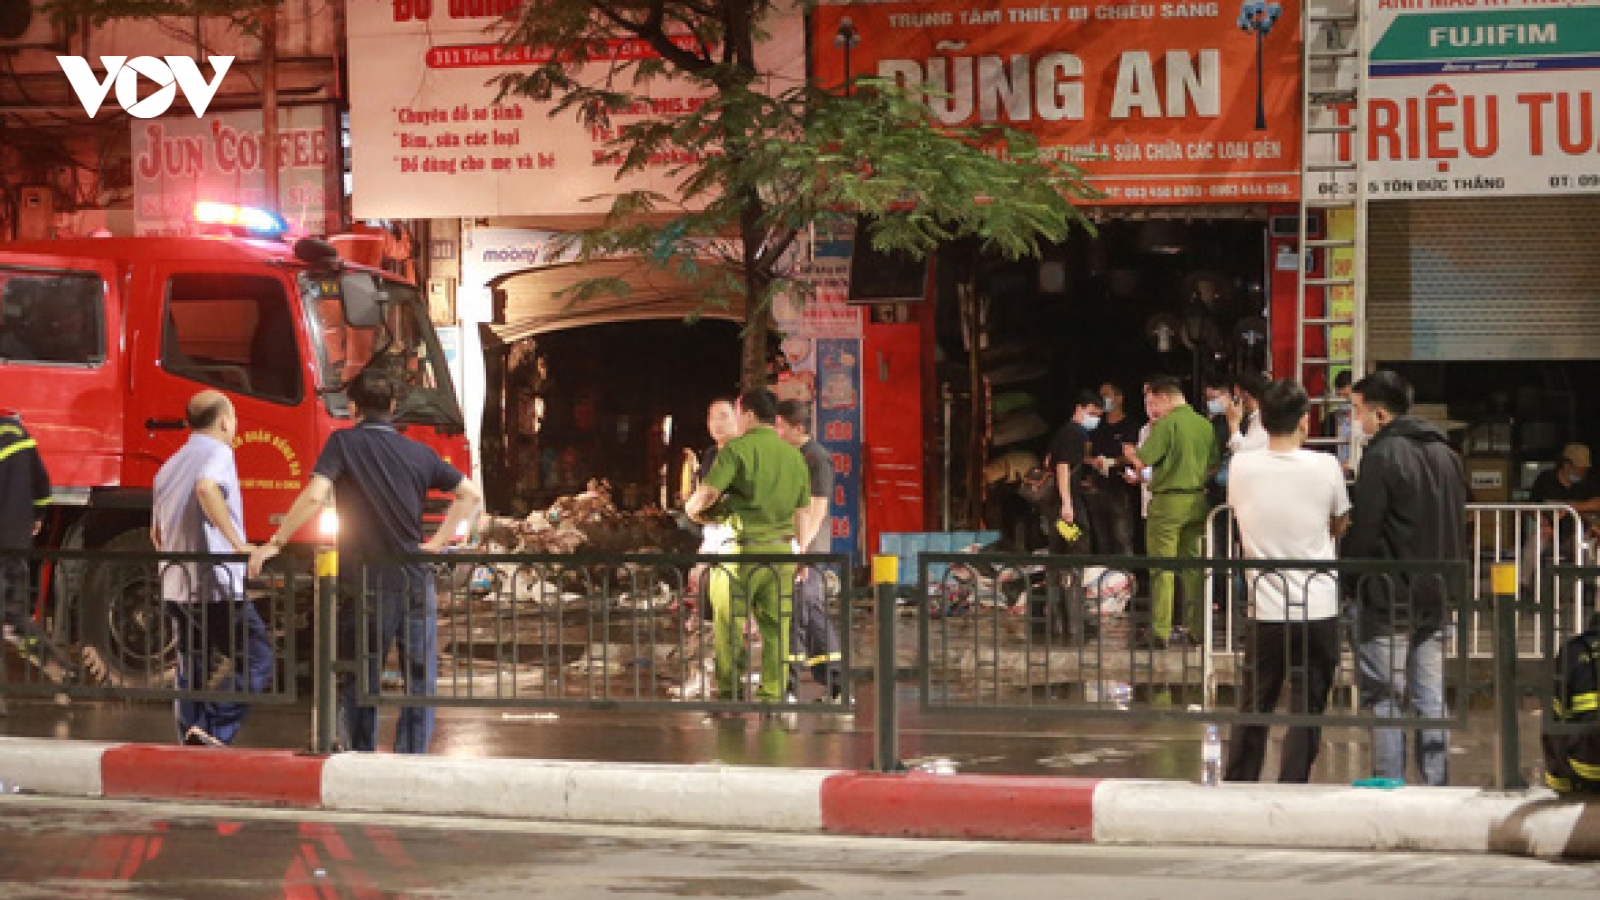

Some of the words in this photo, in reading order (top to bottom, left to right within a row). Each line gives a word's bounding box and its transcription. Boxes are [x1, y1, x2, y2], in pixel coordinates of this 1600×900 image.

[889, 12, 953, 28] TRUNG
[960, 7, 1002, 25] TÂM
[1008, 2, 1060, 23] THIẾT
[1160, 0, 1219, 18] SÁNG
[1429, 24, 1558, 47] FUJIFIM
[1110, 49, 1221, 119] AN
[1327, 83, 1500, 172] TRIỆU
[1517, 91, 1600, 156] TU
[484, 246, 539, 265] moony
